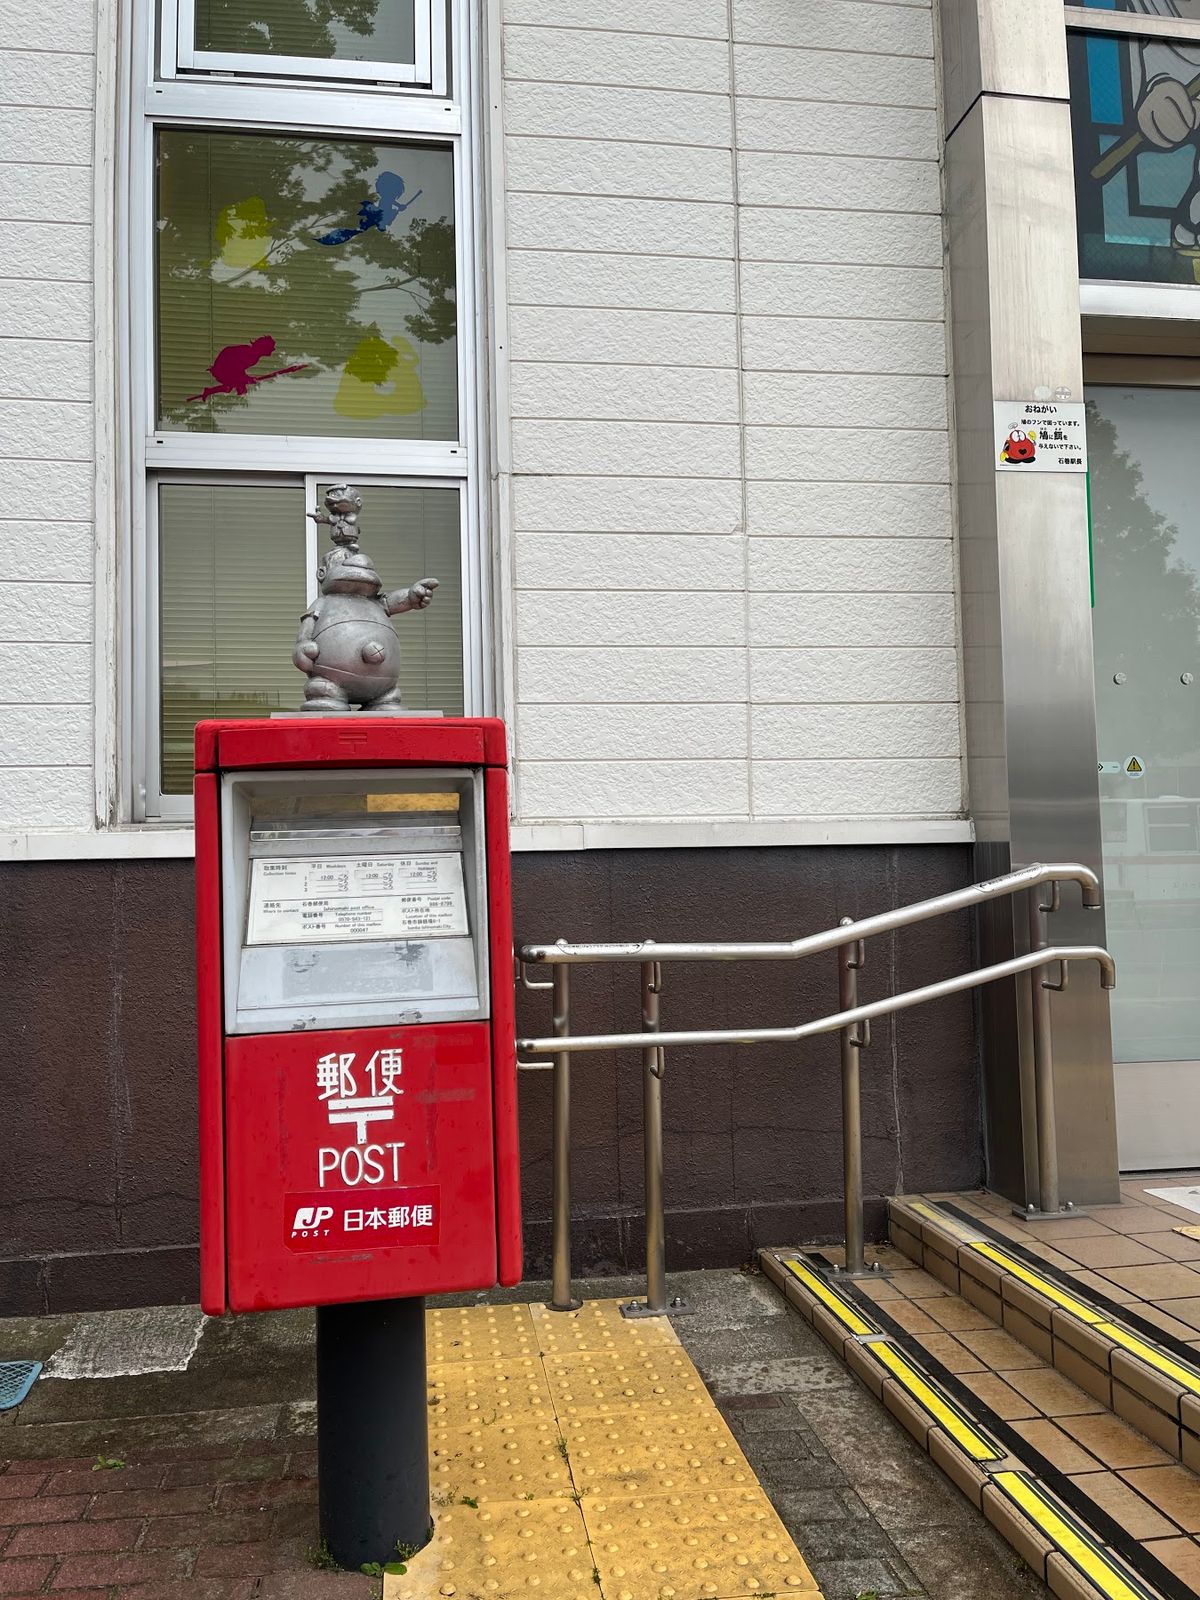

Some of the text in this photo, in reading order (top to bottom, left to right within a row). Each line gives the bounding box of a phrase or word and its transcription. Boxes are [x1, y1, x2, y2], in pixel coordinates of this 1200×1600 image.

[1025, 405, 1057, 413] おねがい
[317, 1048, 404, 1100] 郵便
[318, 1142, 405, 1188] POST
[343, 1204, 433, 1232] 日本郵便
[291, 1230, 330, 1239] POST
